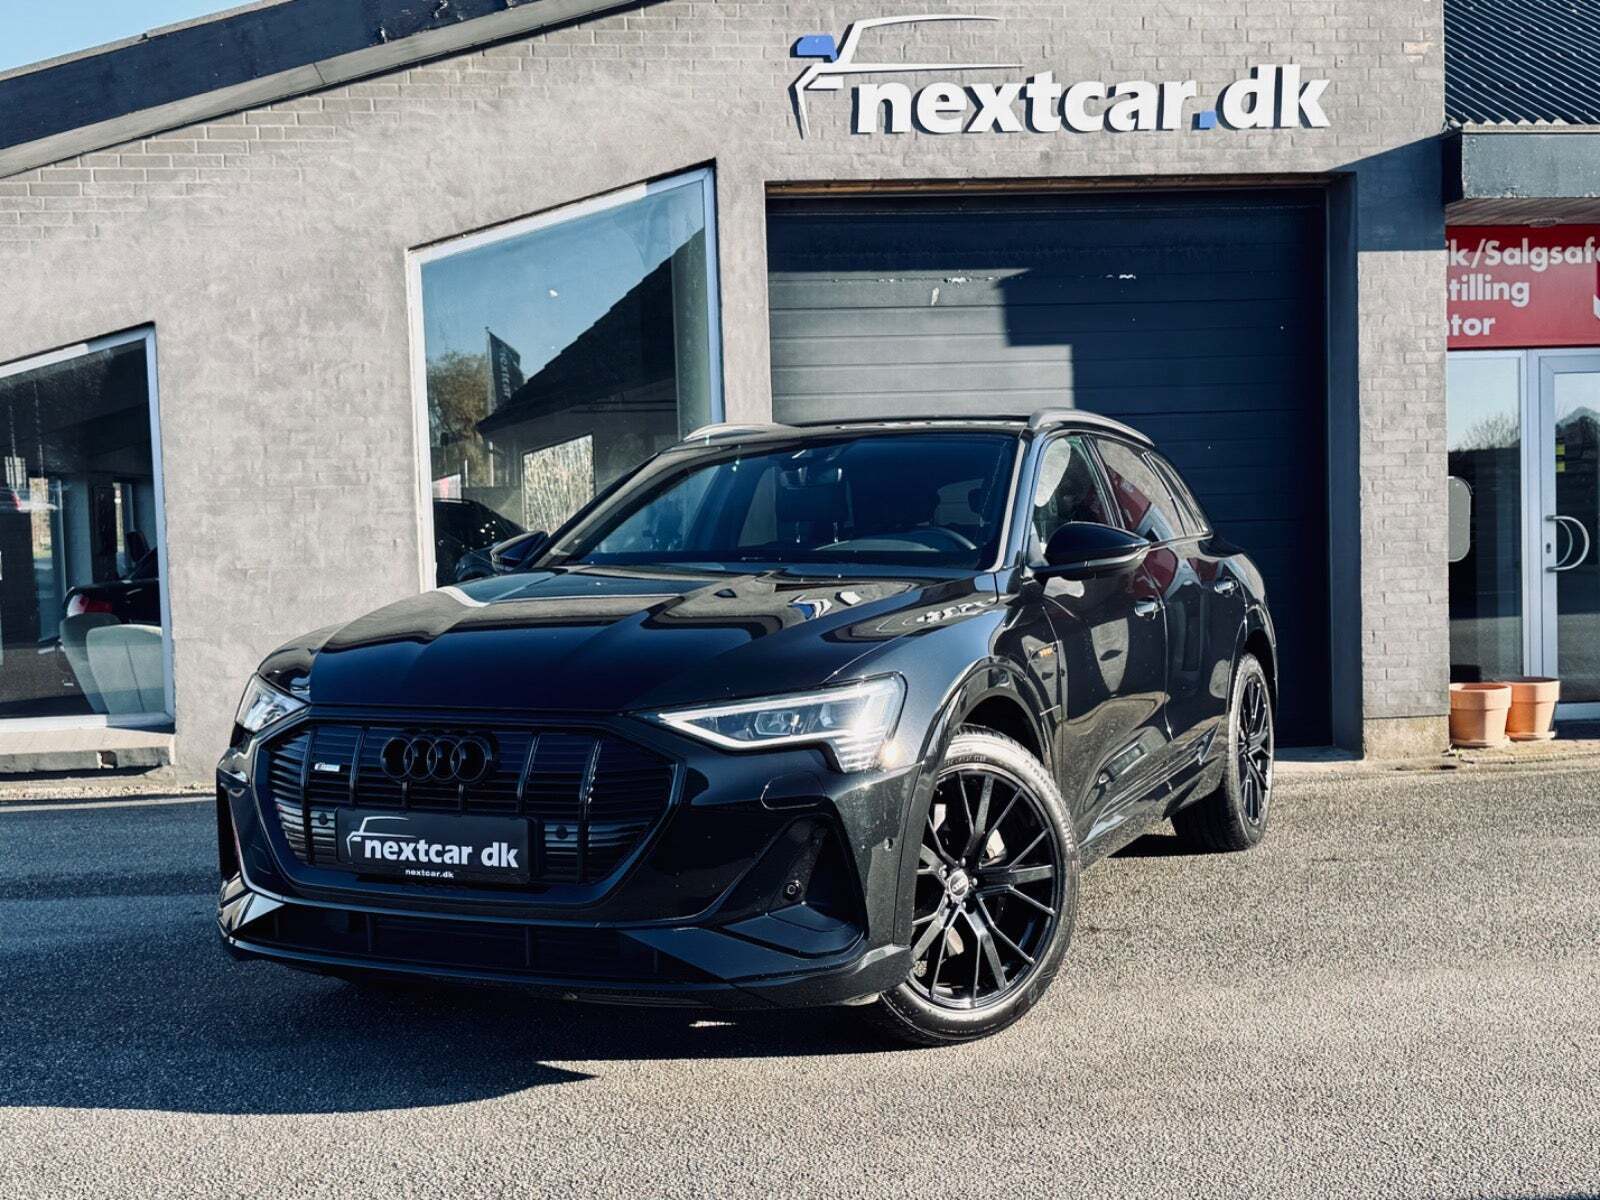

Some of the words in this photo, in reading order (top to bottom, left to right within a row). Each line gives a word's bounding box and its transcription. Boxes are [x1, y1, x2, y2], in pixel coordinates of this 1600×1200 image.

[854, 63, 1331, 134] nextcar.dk
[1446, 236, 1600, 272] k/Salgsaf
[1447, 273, 1530, 308] tilling
[1446, 314, 1496, 337] tor
[364, 838, 473, 865] nextcar
[481, 841, 519, 868] dk
[405, 868, 454, 878] nextcar.dk
